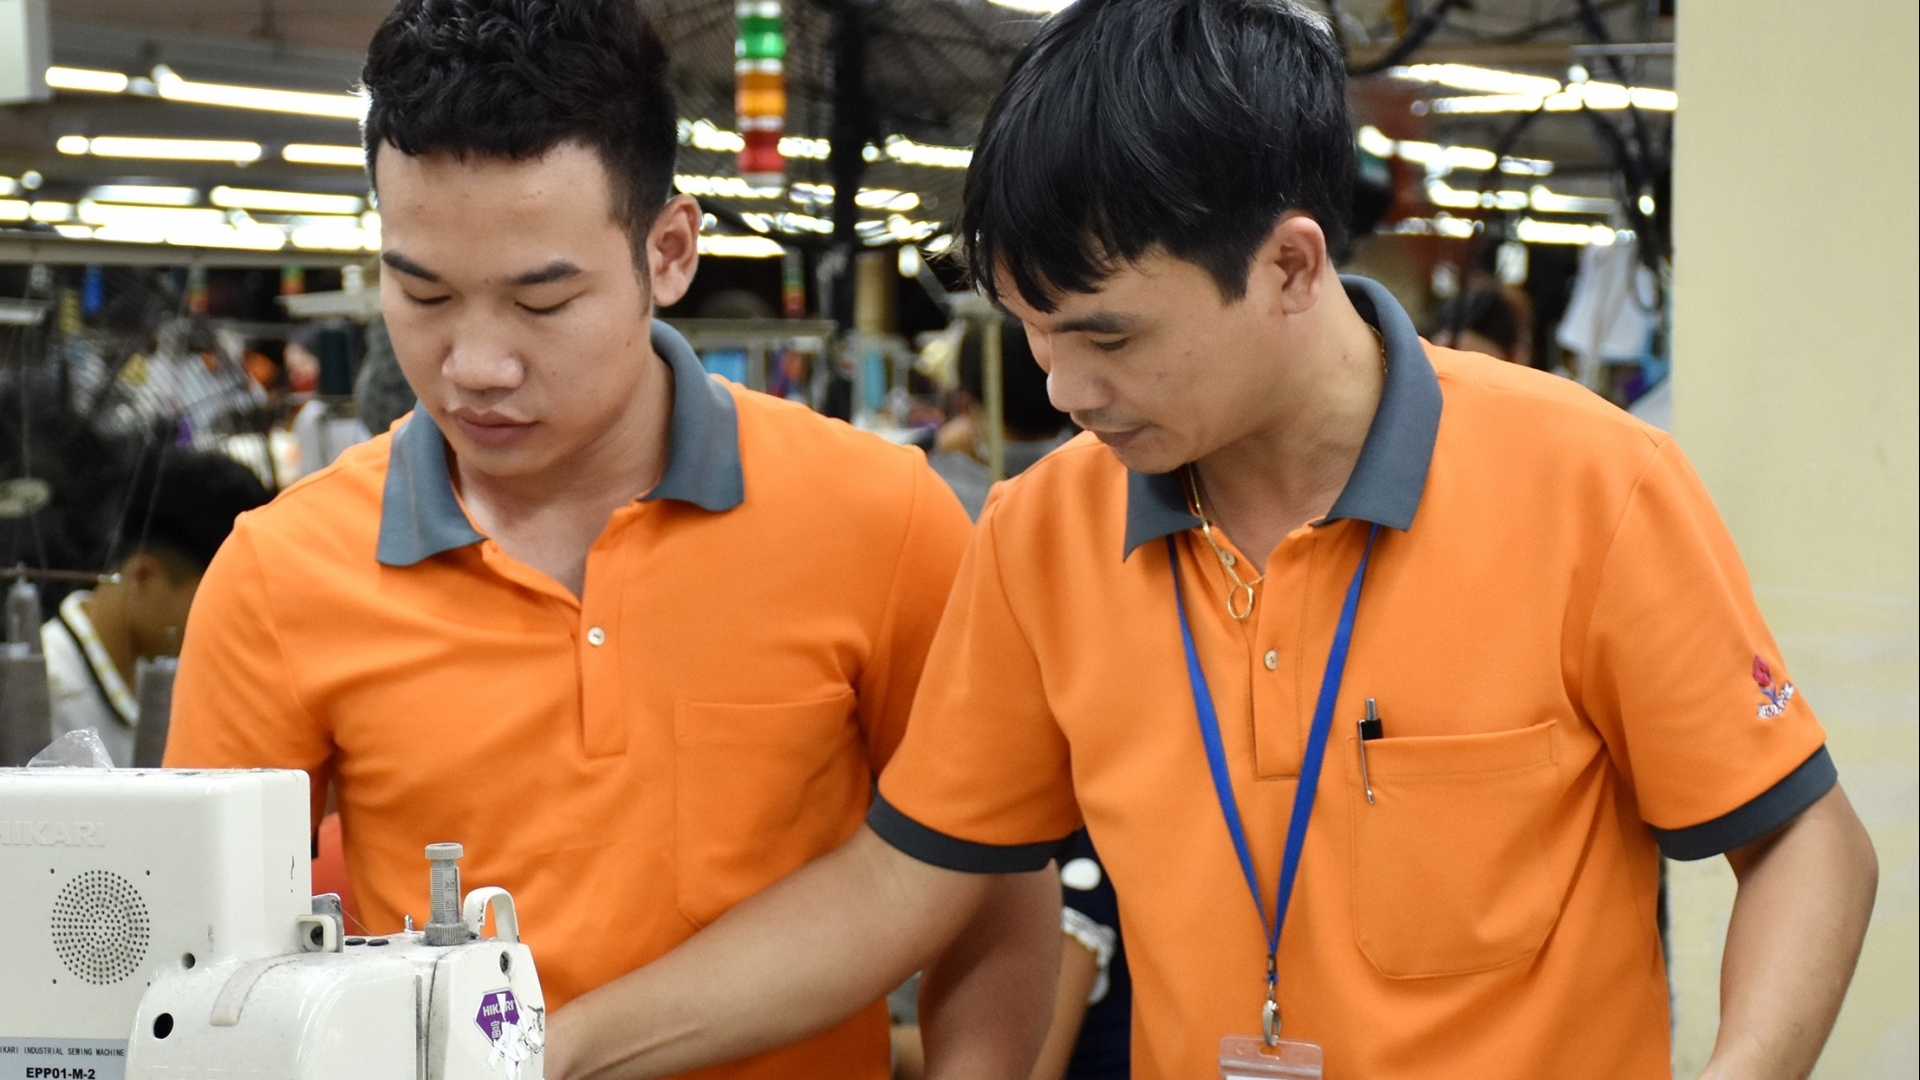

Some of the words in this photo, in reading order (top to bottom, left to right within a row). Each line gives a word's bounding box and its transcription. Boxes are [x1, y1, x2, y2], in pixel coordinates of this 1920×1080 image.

[24, 1046, 63, 1055] INDUSTRIAL
[67, 1047, 92, 1056] SEWING
[95, 1048, 125, 1057] MACHINE
[26, 1067, 96, 1080] EPP01-M-2
